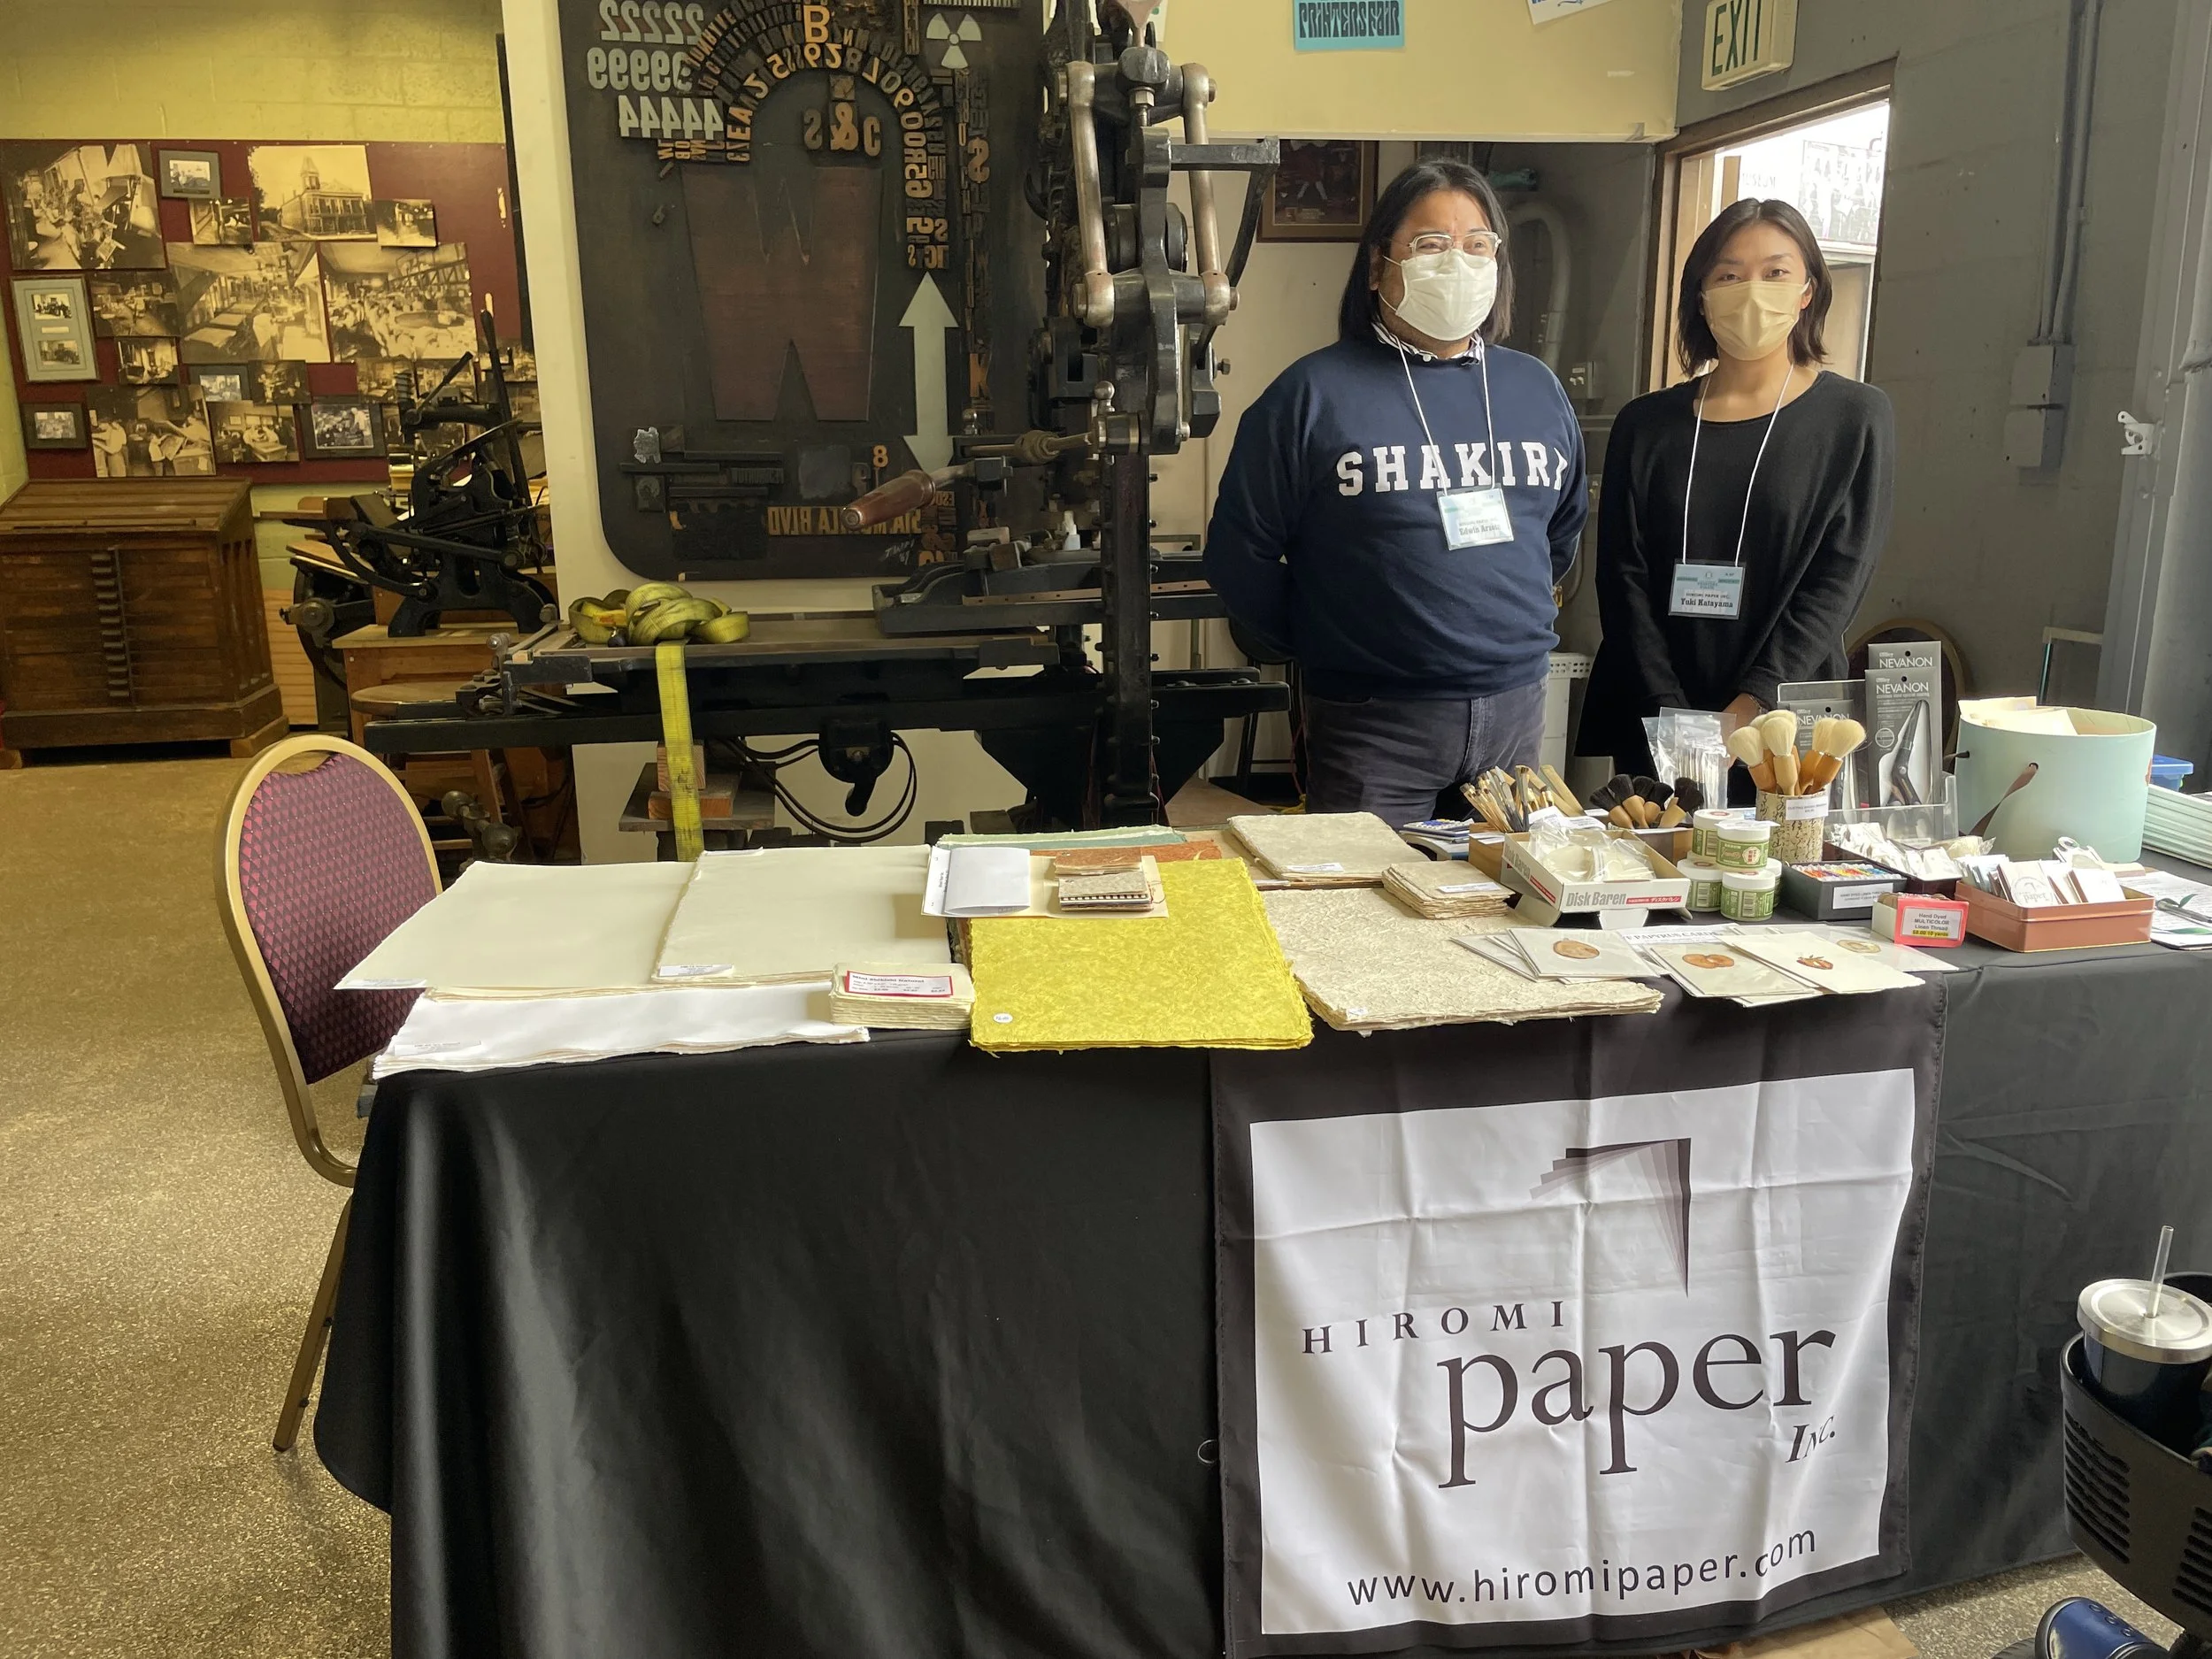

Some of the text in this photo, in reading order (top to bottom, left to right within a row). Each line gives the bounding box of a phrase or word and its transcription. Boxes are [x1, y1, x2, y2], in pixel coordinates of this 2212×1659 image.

[1711, 0, 1762, 76] EXIT
[1681, 597, 1733, 608] Yuki Katayama
[1876, 681, 1929, 695] NEVANON
[1879, 657, 1933, 669] NEVANON
[1565, 891, 1627, 907] Disk Baren
[1302, 1300, 1566, 1356] HIROMI
[1437, 1327, 1837, 1490] paper
[1785, 1415, 1837, 1465] INC.
[1348, 1525, 1816, 1607] www.hiromipaper.com
